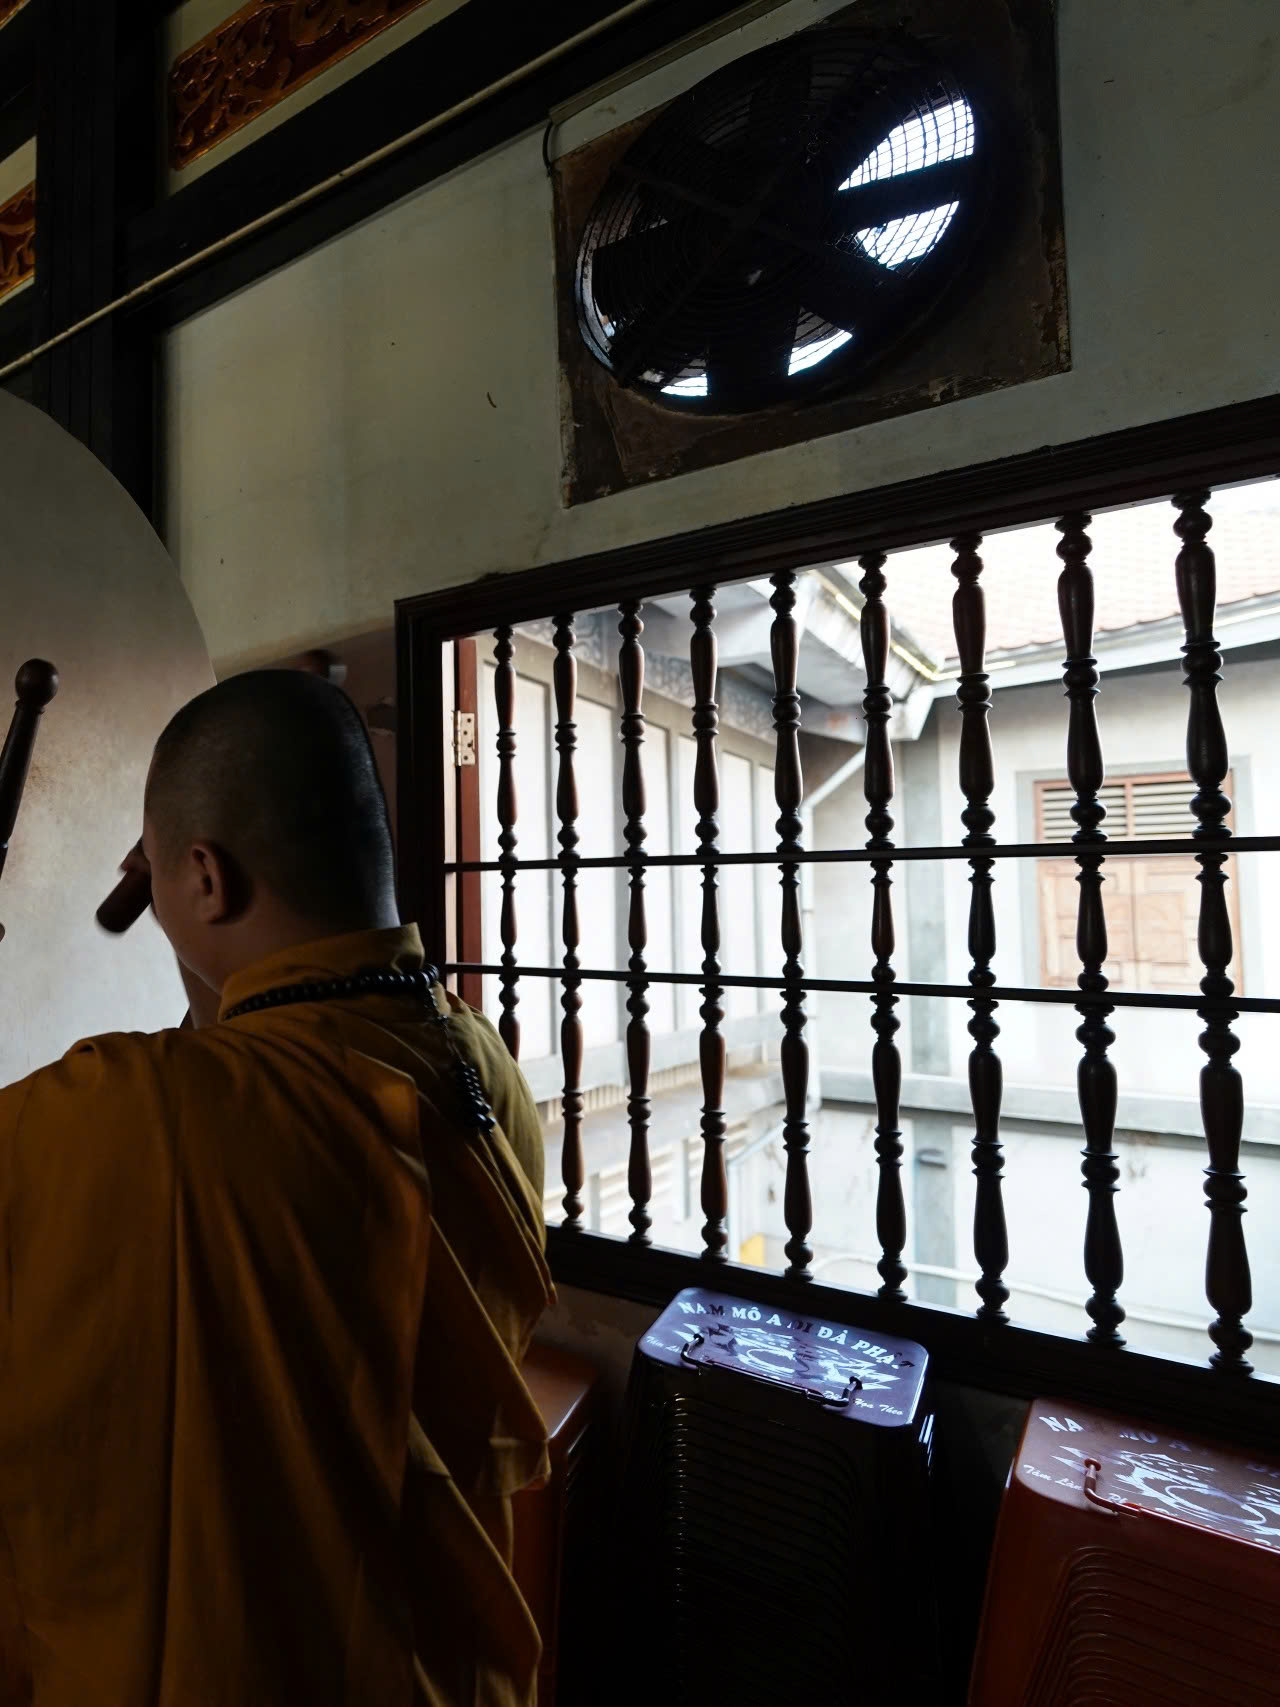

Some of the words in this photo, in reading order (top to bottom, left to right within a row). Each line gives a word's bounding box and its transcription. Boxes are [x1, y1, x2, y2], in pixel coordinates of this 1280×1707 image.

[731, 1306, 762, 1321] MÔ
[765, 1313, 782, 1326] A
[878, 1404, 904, 1416] Theo
[1023, 1463, 1053, 1481] Tâm
